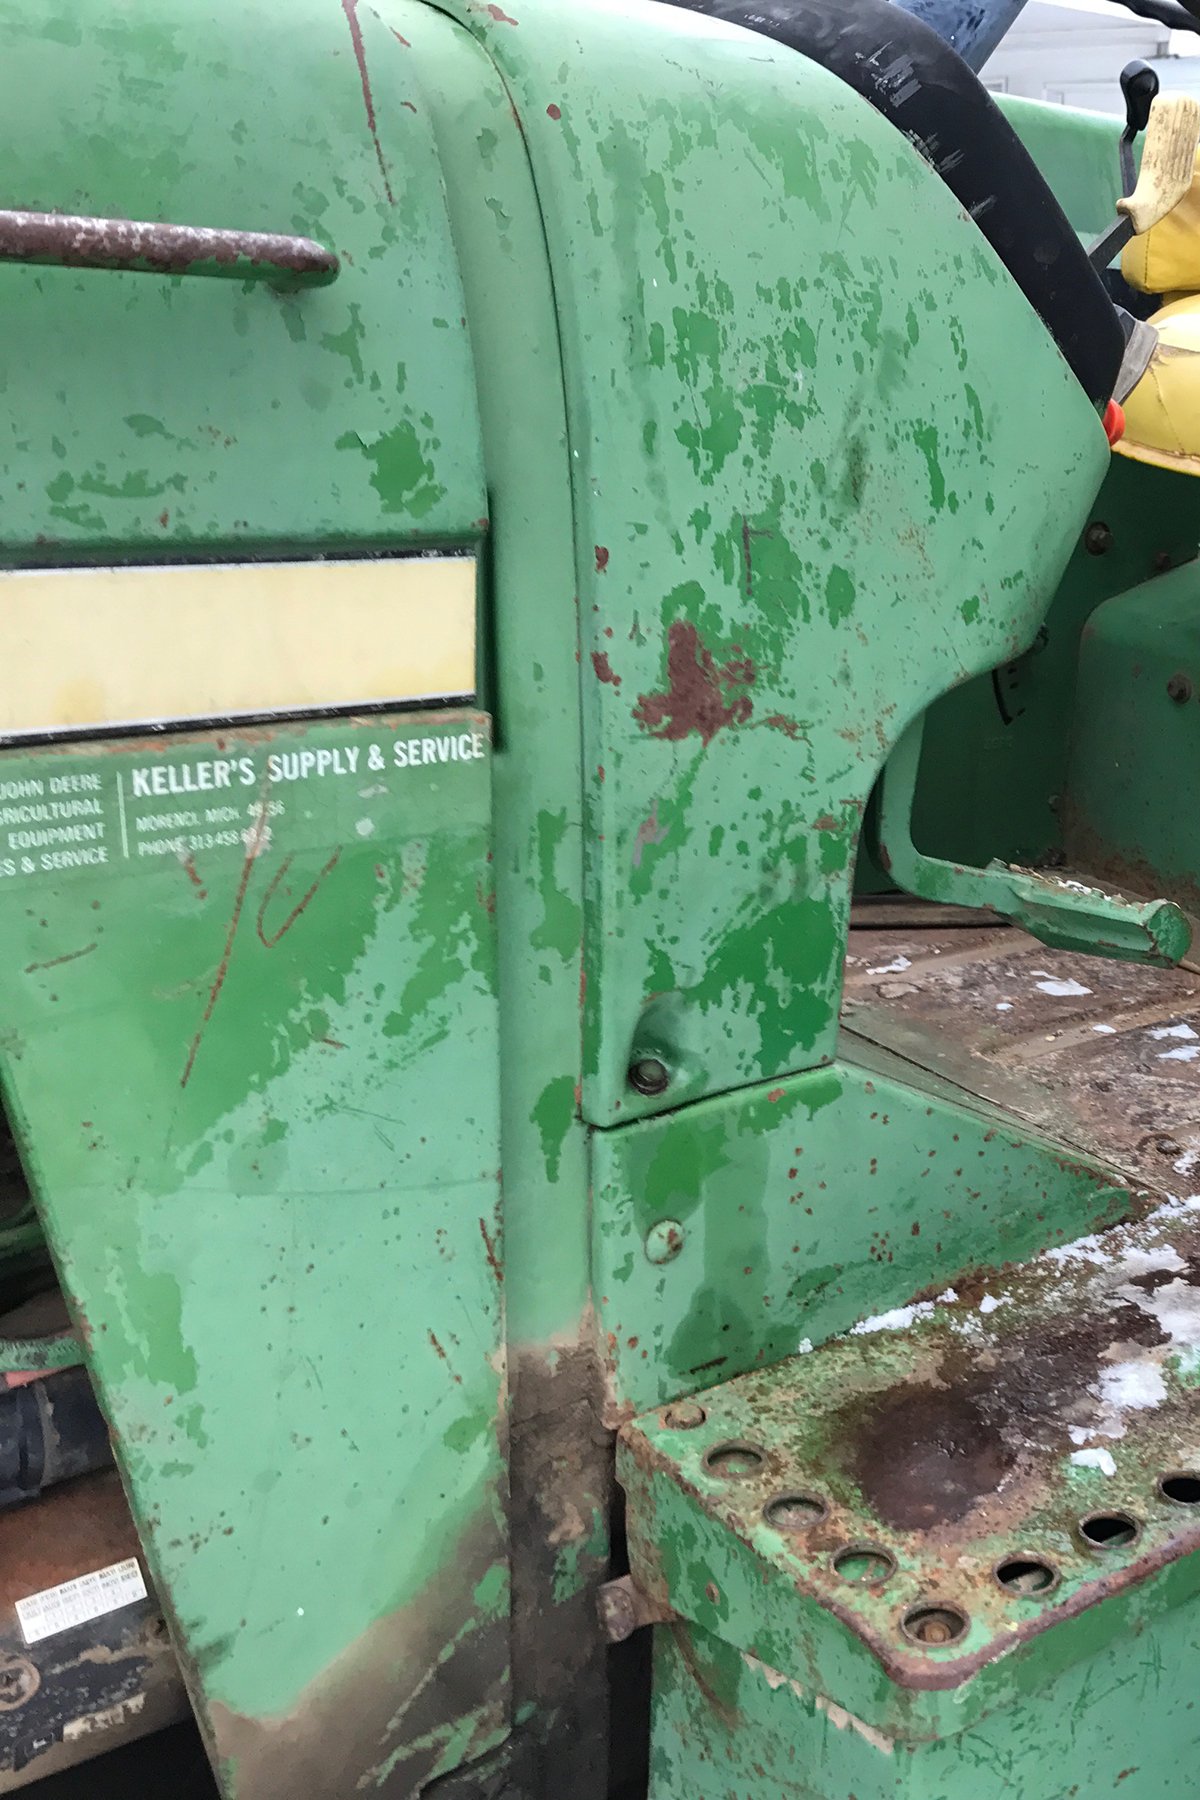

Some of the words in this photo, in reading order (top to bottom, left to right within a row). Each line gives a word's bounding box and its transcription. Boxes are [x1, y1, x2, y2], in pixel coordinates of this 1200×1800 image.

[132, 757, 256, 797] KELLER'S
[268, 746, 360, 782] SUPPLY
[367, 743, 386, 770] &
[393, 732, 485, 767] SERVICE
[50, 773, 103, 794] DEERE
[8, 822, 106, 850] EQUIPMENT
[20, 856, 36, 873] &
[40, 846, 109, 870] SERVICE
